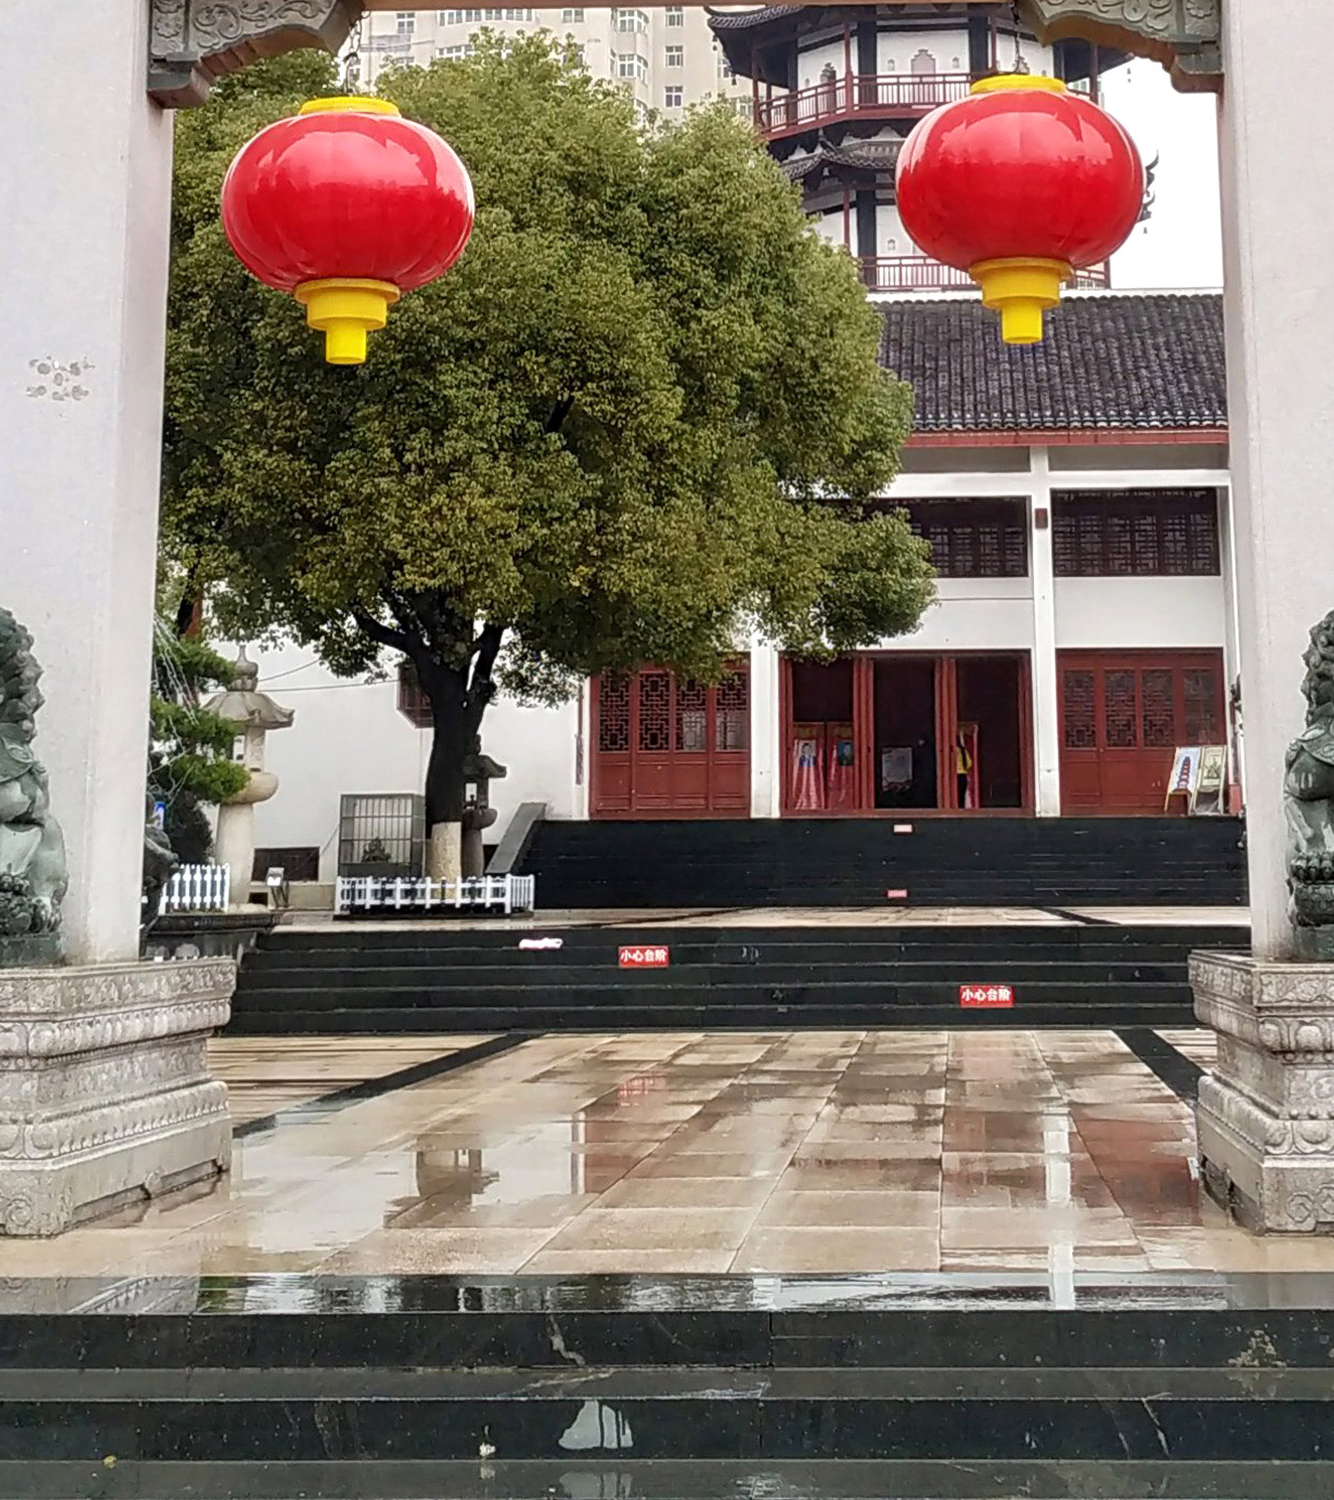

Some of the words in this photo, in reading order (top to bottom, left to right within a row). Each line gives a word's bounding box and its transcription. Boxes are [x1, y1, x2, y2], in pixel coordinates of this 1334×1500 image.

[619, 948, 668, 963] 小心台阶
[960, 988, 1012, 1002] 小心台阶
